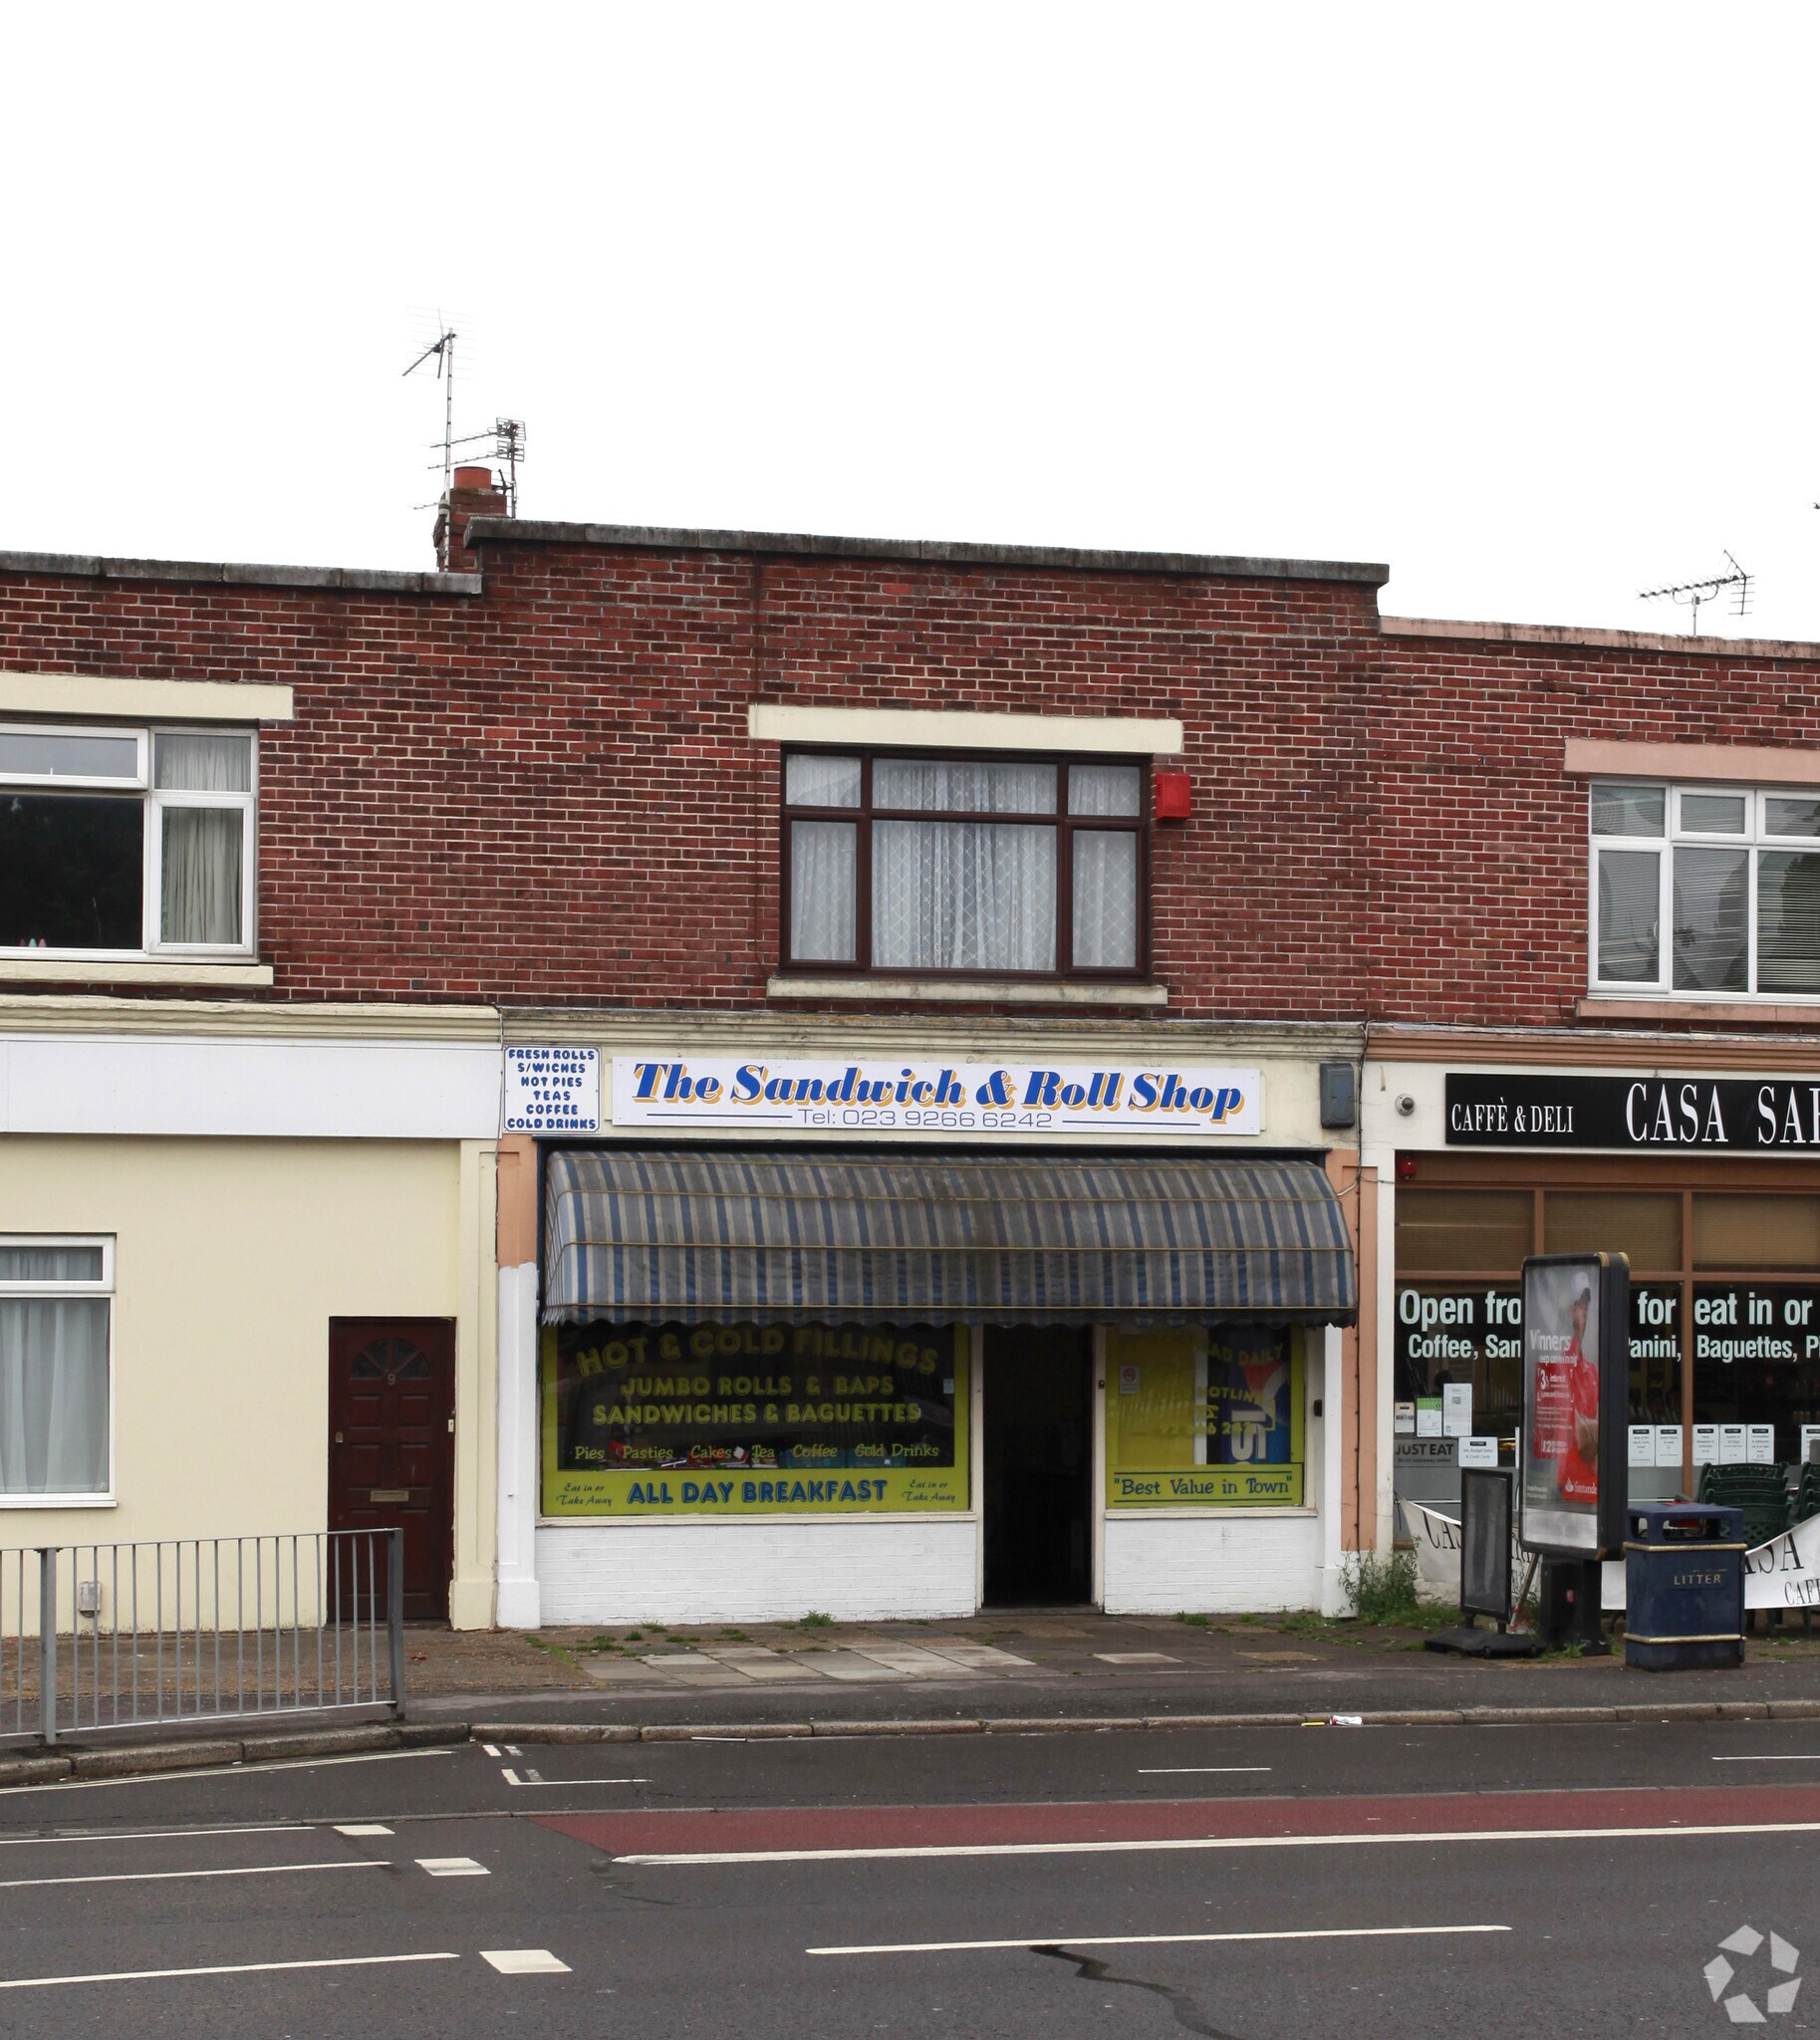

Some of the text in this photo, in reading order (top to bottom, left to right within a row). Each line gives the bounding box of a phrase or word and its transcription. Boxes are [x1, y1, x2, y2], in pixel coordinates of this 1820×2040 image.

[508, 1049, 595, 1061] FRESH ROLLS
[517, 1062, 586, 1074] S/WICHES
[520, 1076, 583, 1088] HOT PIES
[533, 1090, 571, 1101] TEAS
[633, 1063, 1245, 1125] The Sandwich & Roll Shop
[526, 1104, 578, 1115] COFFEE
[1451, 1097, 1574, 1133] CAFFÈ & DELI
[1626, 1083, 1728, 1143] CASA
[507, 1118, 596, 1130] COLD DRINKS
[798, 1109, 1052, 1129] Tel: 023 9266 6242
[1399, 1289, 1473, 1332] Open
[1638, 1291, 1677, 1325] for
[1694, 1293, 1737, 1325] eat
[1748, 1291, 1772, 1325] in
[1784, 1299, 1813, 1326] or
[577, 1328, 938, 1377] HOT & COLD FILLINGS
[1409, 1334, 1478, 1360] Coffee,
[1628, 1335, 1681, 1362] anini,
[1696, 1335, 1798, 1364] Baguettes,
[388, 1373, 395, 1386] 9
[621, 1376, 894, 1396] JUMBO ROLLS & BAPS
[592, 1402, 921, 1424] SANDWICHES & BAGUETTES
[575, 1443, 938, 1459] Pies Pasties Cakes Tea Coffee Cold Drinks
[1395, 1443, 1453, 1455] JUST EAT
[564, 1483, 581, 1492] Eat
[910, 1479, 925, 1488] Eat
[1170, 1478, 1213, 1494] Value
[1222, 1479, 1237, 1494] in
[627, 1479, 888, 1504] ALL DAY BREAKFAST
[902, 1491, 955, 1503] Take Away
[556, 1495, 612, 1507] Take Away
[1674, 1574, 1721, 1585] LITTER
